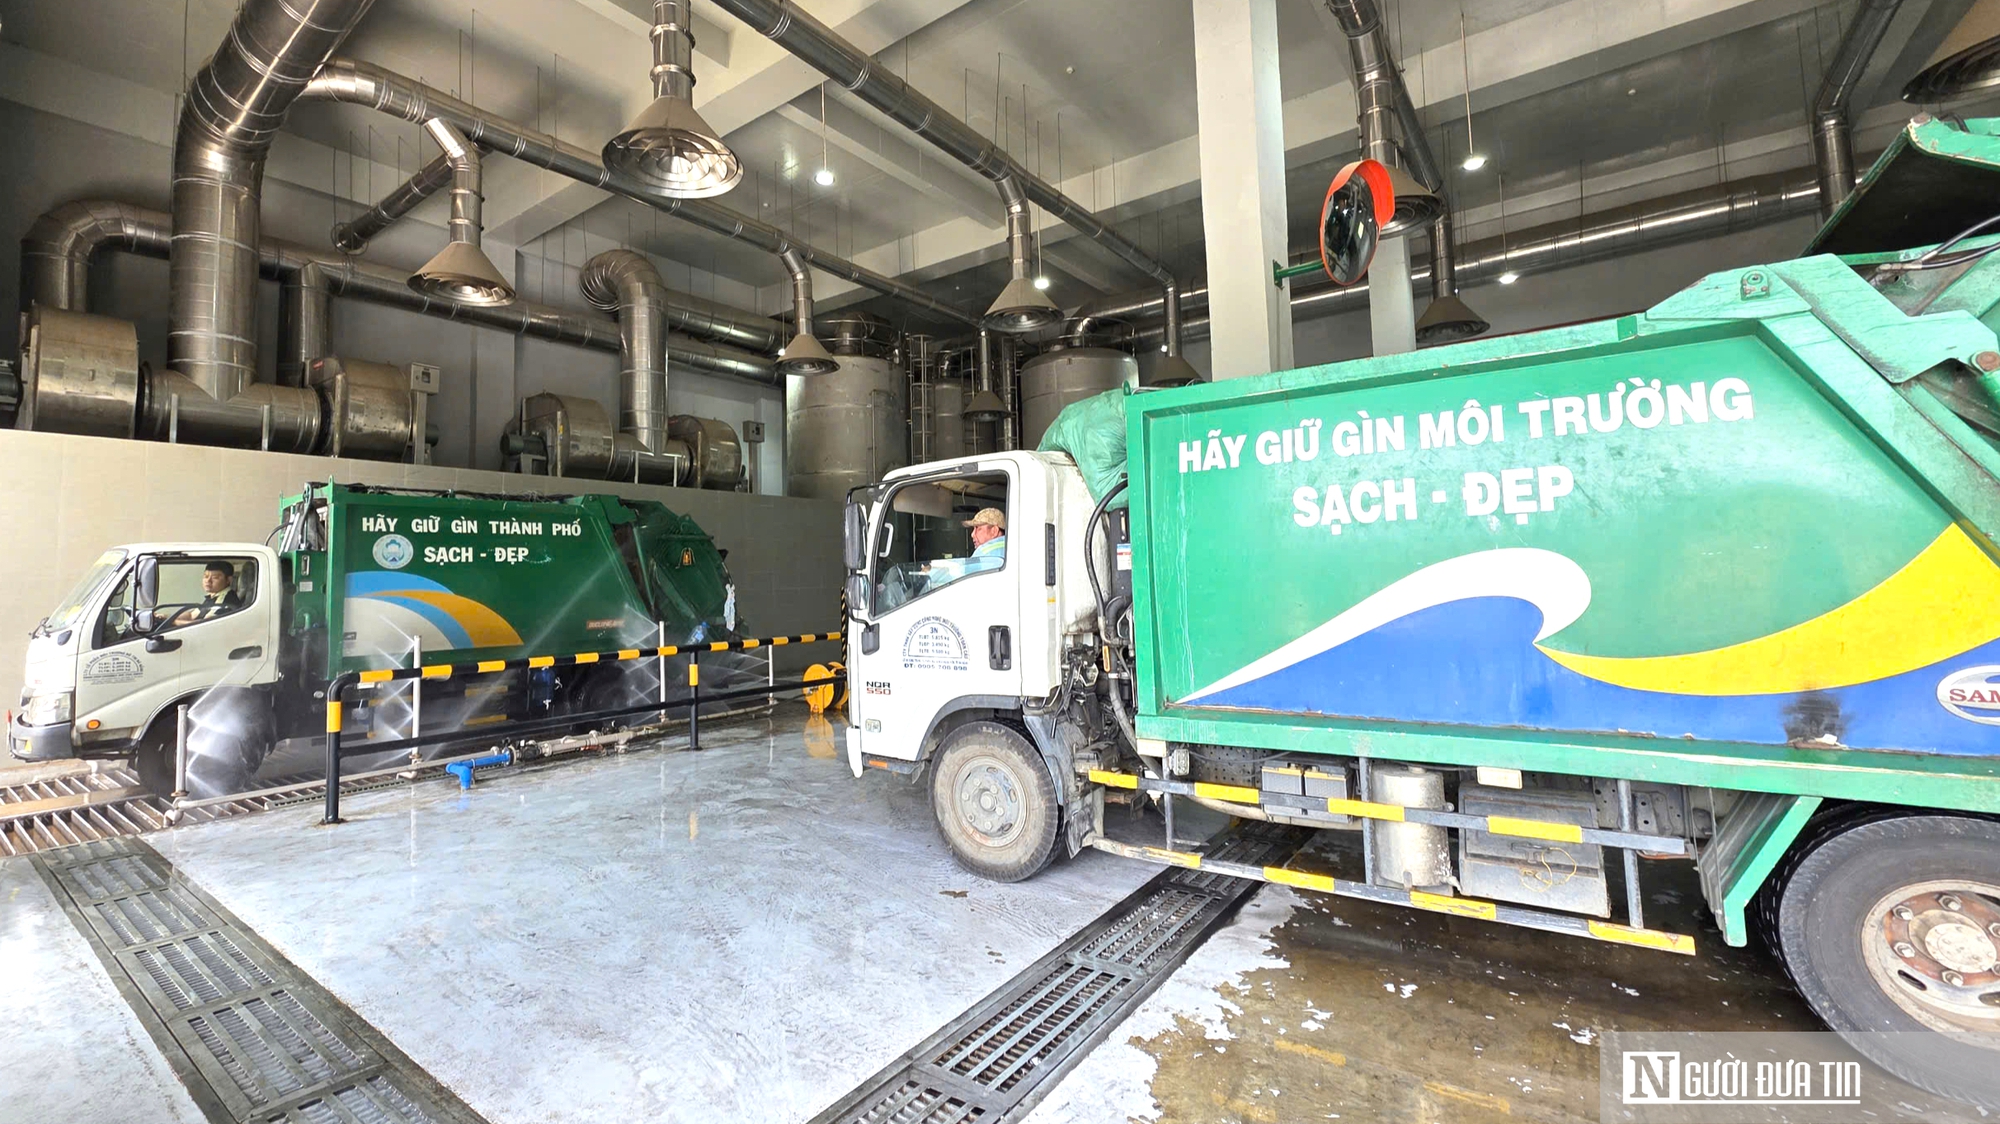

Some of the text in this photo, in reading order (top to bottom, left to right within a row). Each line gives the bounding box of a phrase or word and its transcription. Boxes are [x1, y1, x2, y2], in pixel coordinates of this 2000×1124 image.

[1178, 376, 1755, 474] HÃY GIỮ GÌN MÔI TRƯỜNG
[1292, 477, 1418, 536] SẠCH
[1462, 465, 1575, 525] ĐẸP
[362, 513, 582, 536] HÃY GIỮ GÌN THÀNH PHỐ
[424, 546, 474, 566] SẠCH
[495, 546, 529, 565] ĐẸP
